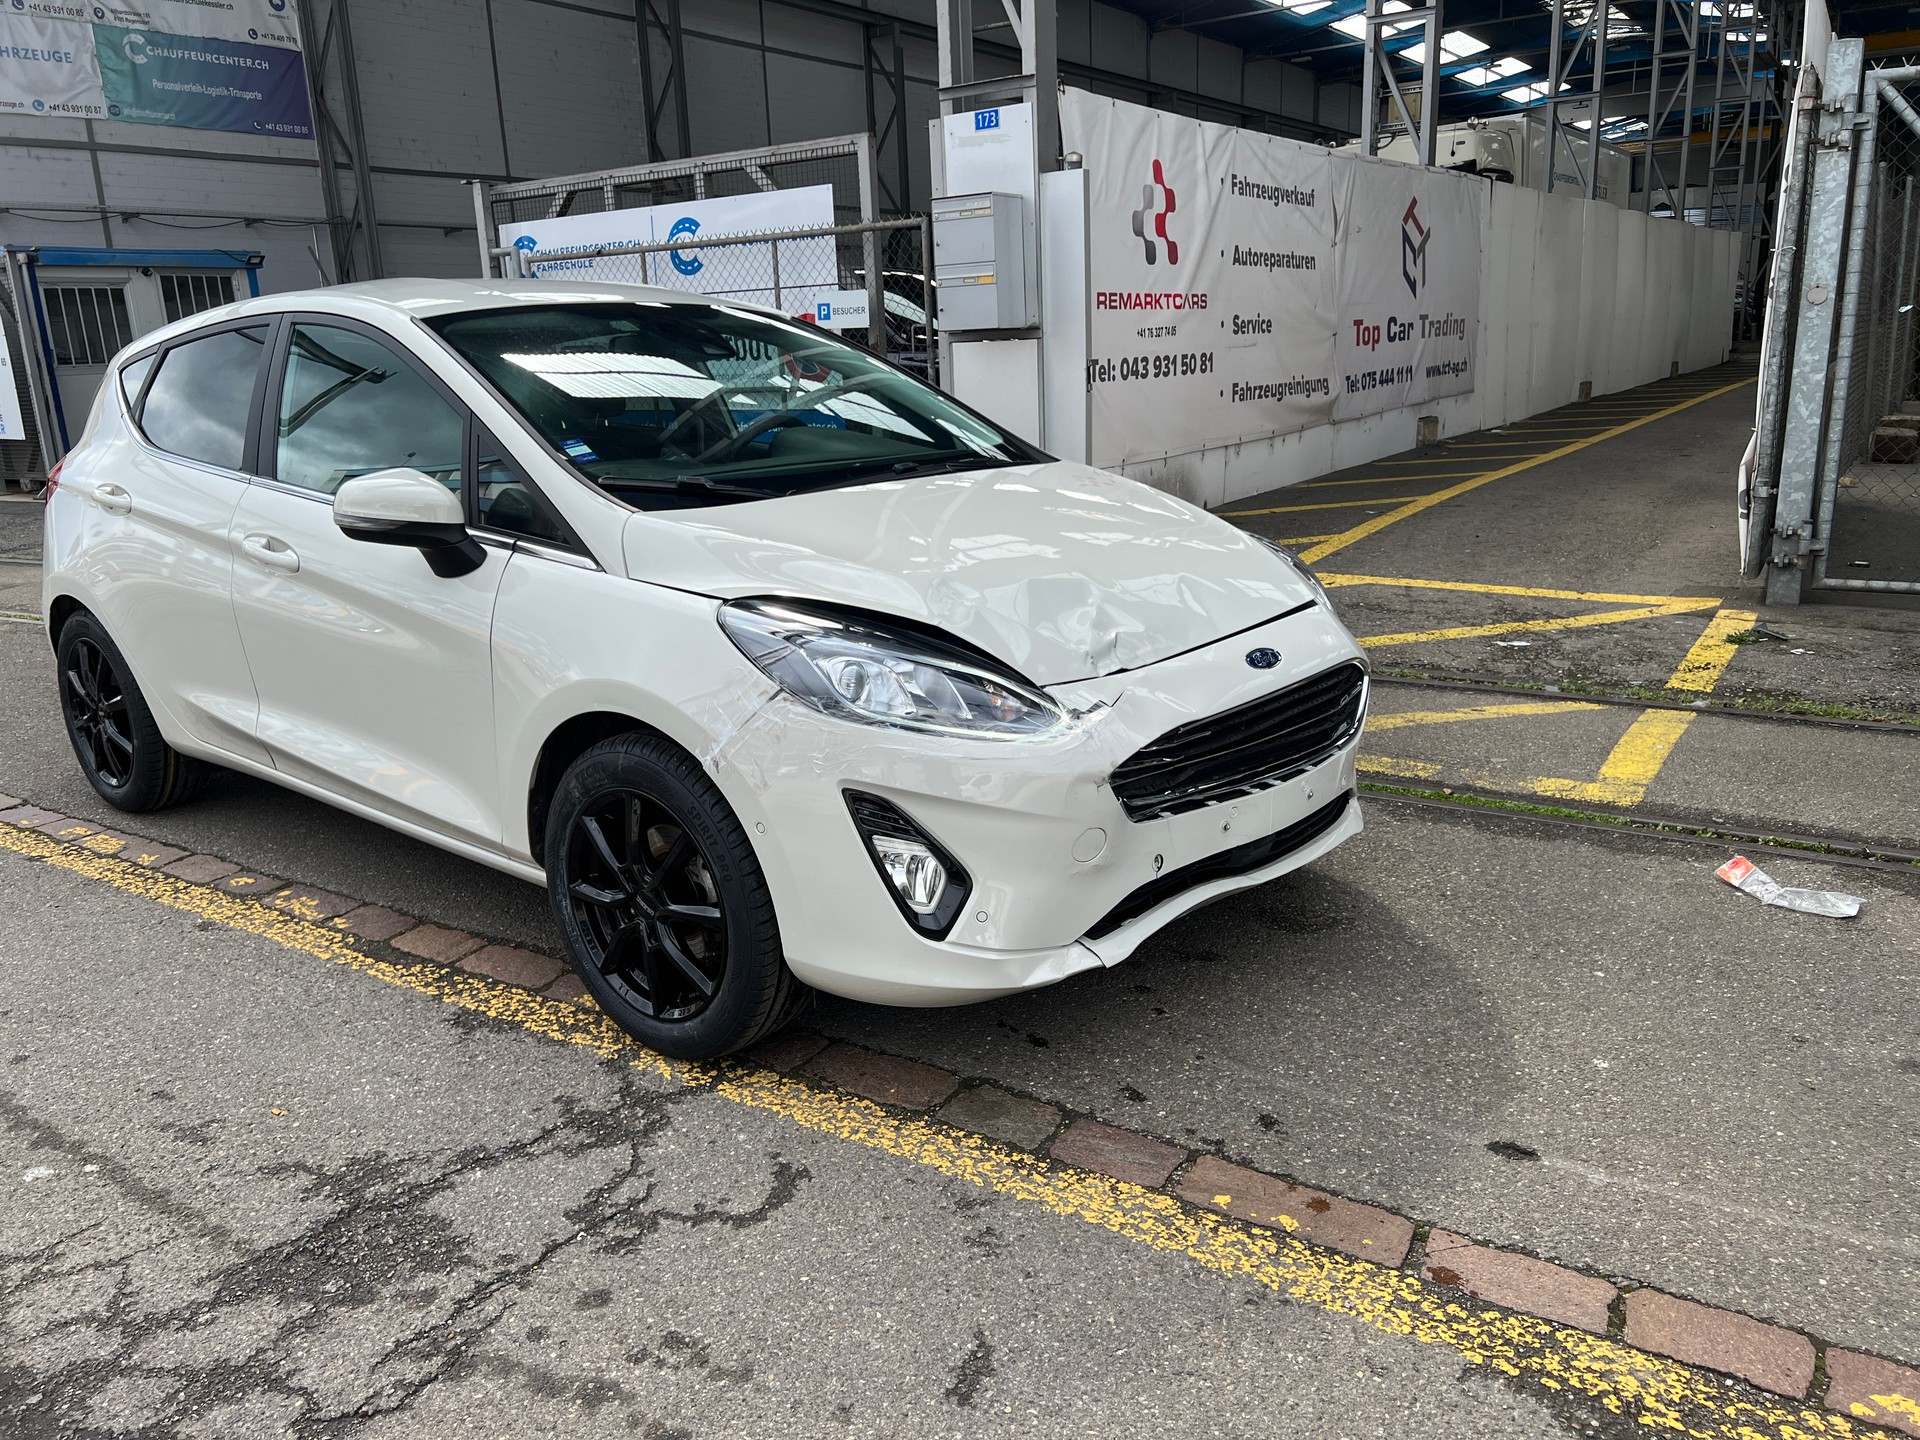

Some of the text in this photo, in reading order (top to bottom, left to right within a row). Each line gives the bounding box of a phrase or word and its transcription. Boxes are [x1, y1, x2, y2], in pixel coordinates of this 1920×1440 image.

[29, 3, 41, 11] +41
[43, 4, 51, 13] 43
[52, 5, 65, 15] 931
[66, 7, 75, 16] 00
[146, 46, 269, 70] CHAUFFEURCENTER.CH
[49, 104, 102, 114] +41 43 931 00 87
[977, 112, 997, 128] 173
[265, 123, 275, 131] +41
[276, 123, 283, 132] 43
[283, 124, 294, 132] 931
[294, 125, 301, 133] 00
[1231, 173, 1316, 208] Fahrzeugverkauf
[536, 258, 594, 273] FAHRSCHULE
[1232, 244, 1317, 273] Autoreparaturen
[832, 306, 866, 316] BESUCHER
[1096, 292, 1208, 310] REMARKTCARS
[1137, 327, 1146, 338] +41
[1154, 326, 1164, 338] 327
[1164, 326, 1170, 337] 74
[1232, 313, 1273, 336] Service
[1353, 313, 1466, 352] Top Car Trading
[1089, 351, 1214, 383] Tel: 043 931 50 81
[1231, 374, 1330, 404] Fahrzeugreinigung
[1345, 374, 1360, 394] Tel:
[1361, 370, 1377, 391] 075
[1378, 367, 1394, 387] 444
[687, 804, 733, 882] SPIRIT PRO
